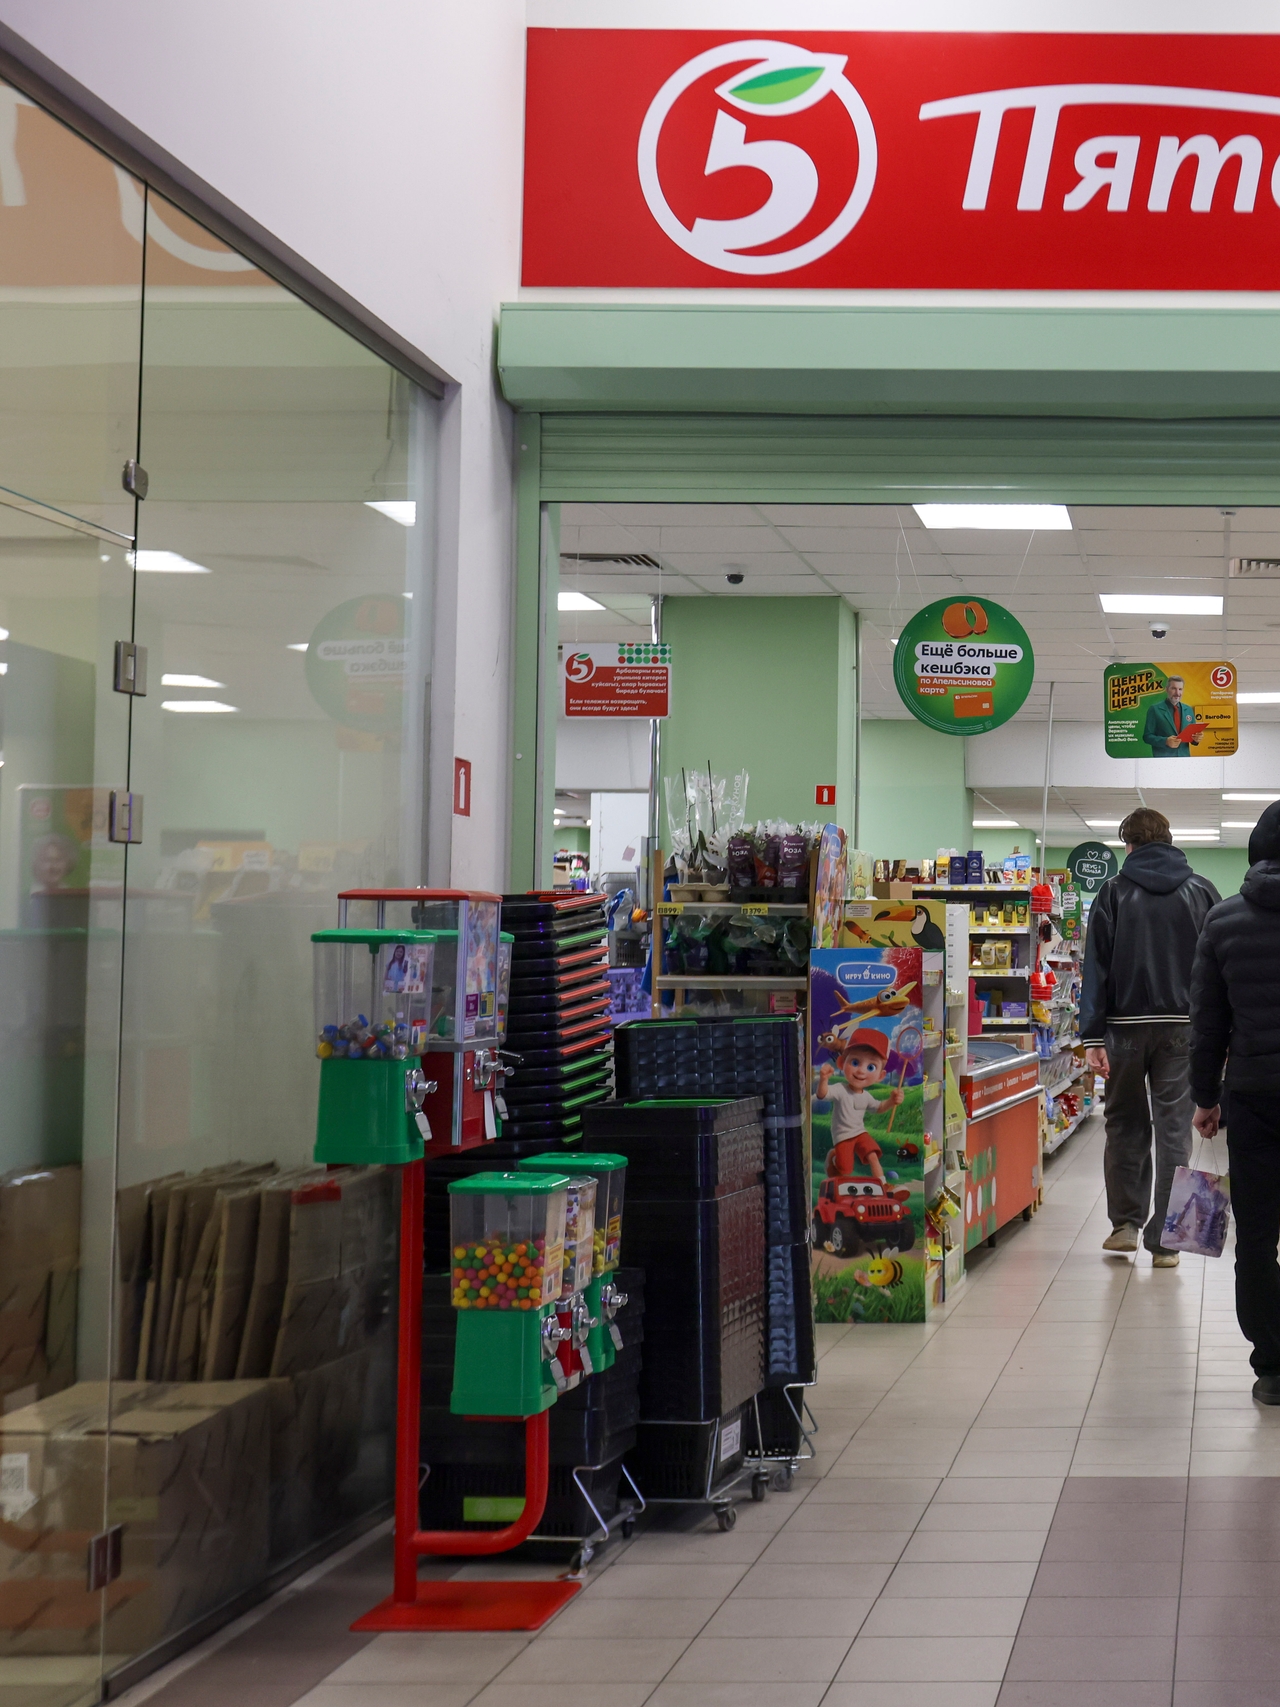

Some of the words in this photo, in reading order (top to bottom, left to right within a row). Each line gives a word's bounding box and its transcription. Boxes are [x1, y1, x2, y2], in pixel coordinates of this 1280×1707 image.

[921, 643, 954, 659] Ещё
[957, 644, 1018, 659] больше
[921, 662, 991, 675] кешбэка
[932, 677, 992, 686] Апельсиновой
[1111, 672, 1153, 689] ЦЕНТР
[920, 687, 945, 695] карте
[1111, 680, 1163, 698] НИЗКИХ
[1111, 696, 1137, 710] ЦЕН
[844, 972, 862, 982] ИГРУ
[870, 972, 891, 982] КИНО
